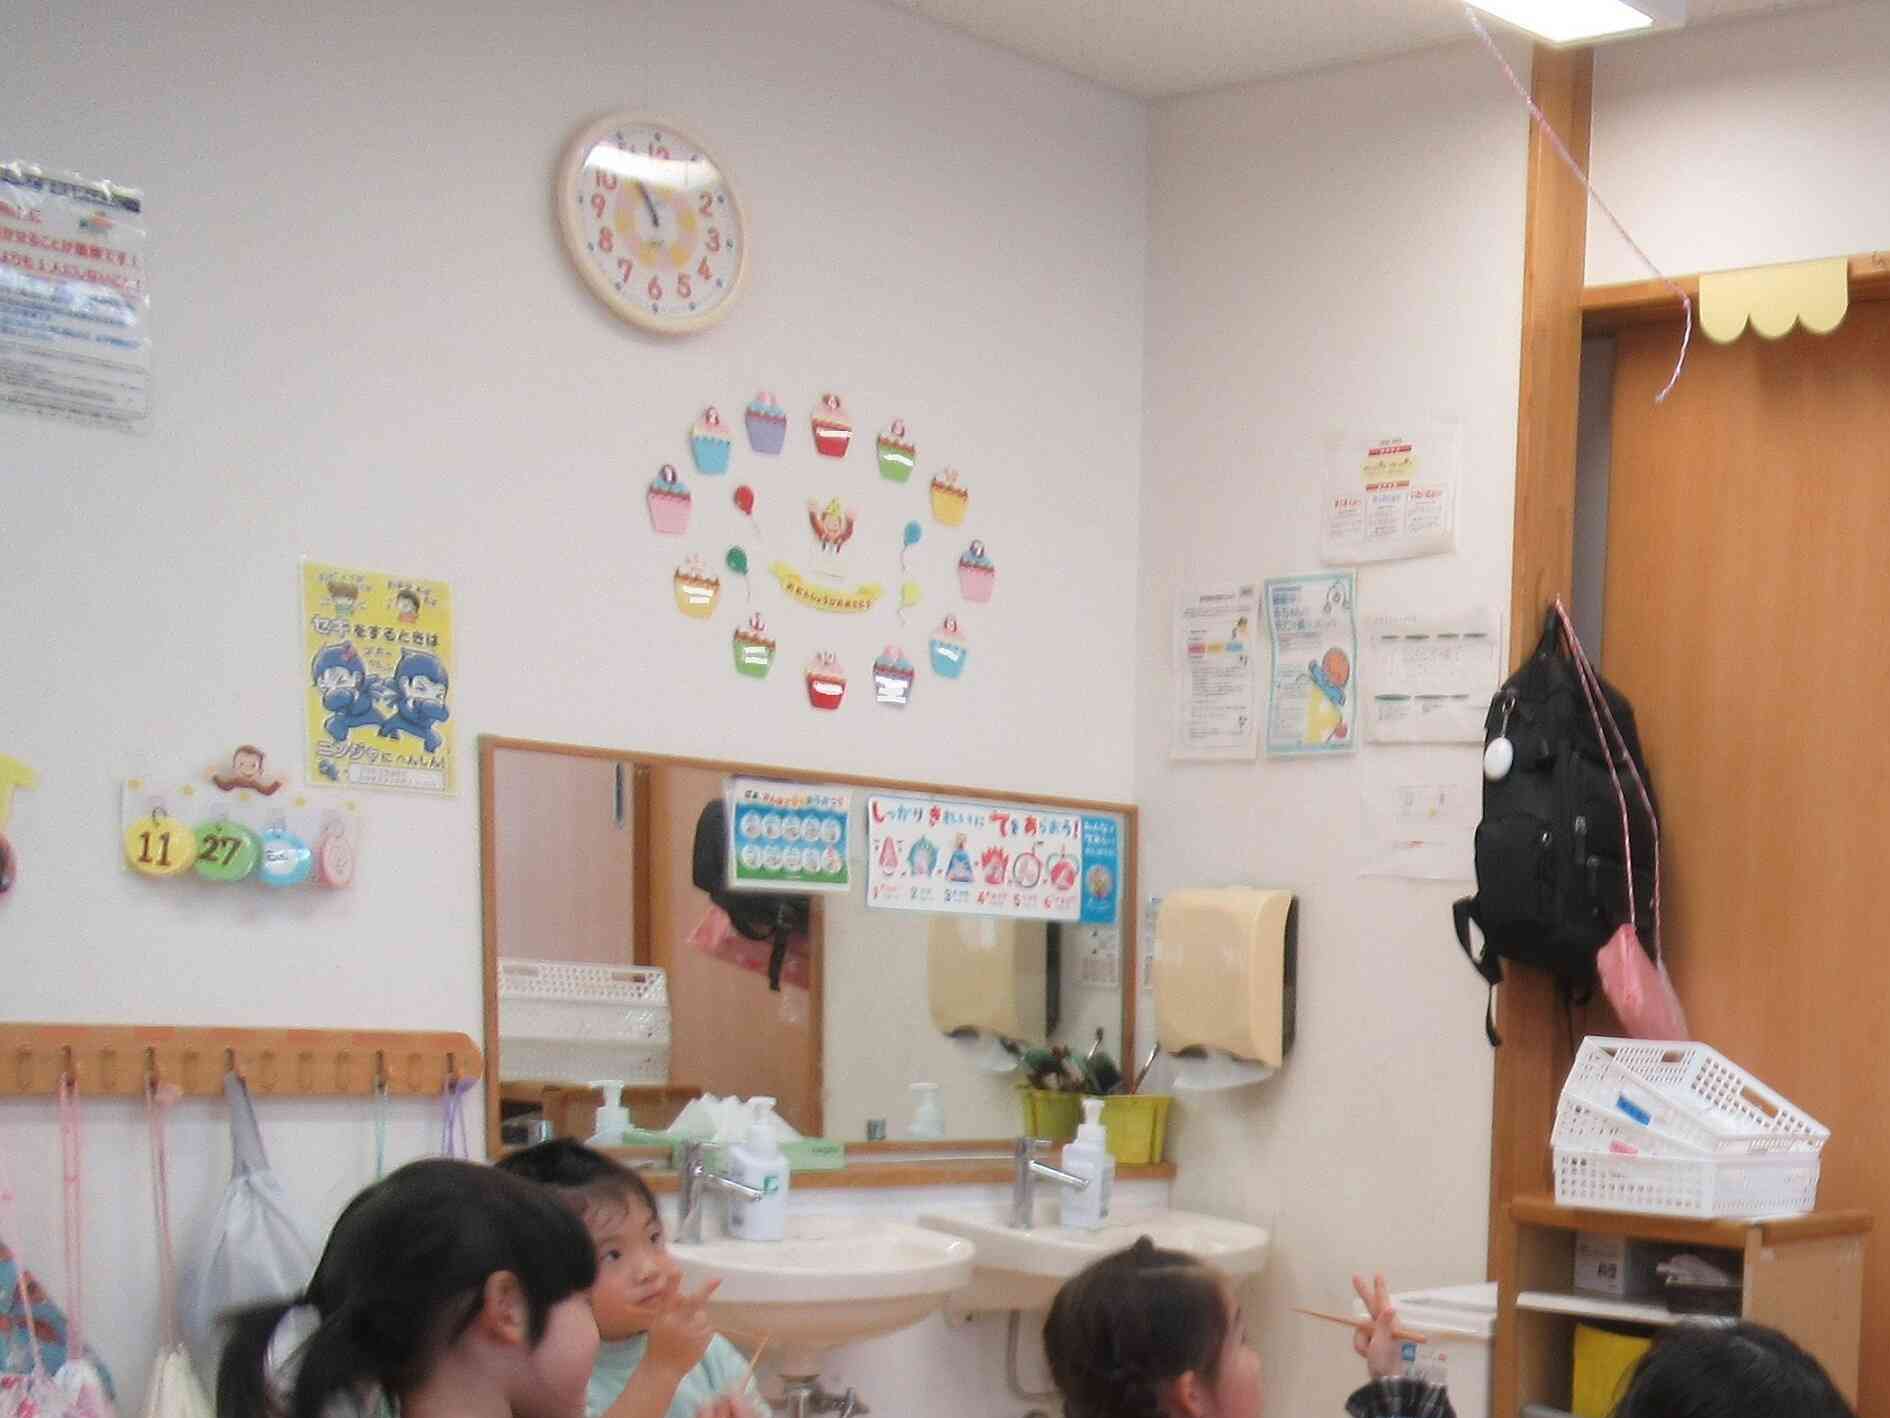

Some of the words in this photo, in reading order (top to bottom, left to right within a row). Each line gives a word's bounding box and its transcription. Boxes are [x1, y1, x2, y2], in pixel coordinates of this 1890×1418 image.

[591, 193, 606, 218] 9
[599, 226, 613, 251] 8
[706, 227, 720, 251] 3
[618, 258, 632, 283] 7
[698, 256, 712, 280] 4
[648, 275, 663, 300] 6
[677, 272, 691, 298] 5
[138, 831, 172, 867] 11
[198, 834, 242, 867] 27
